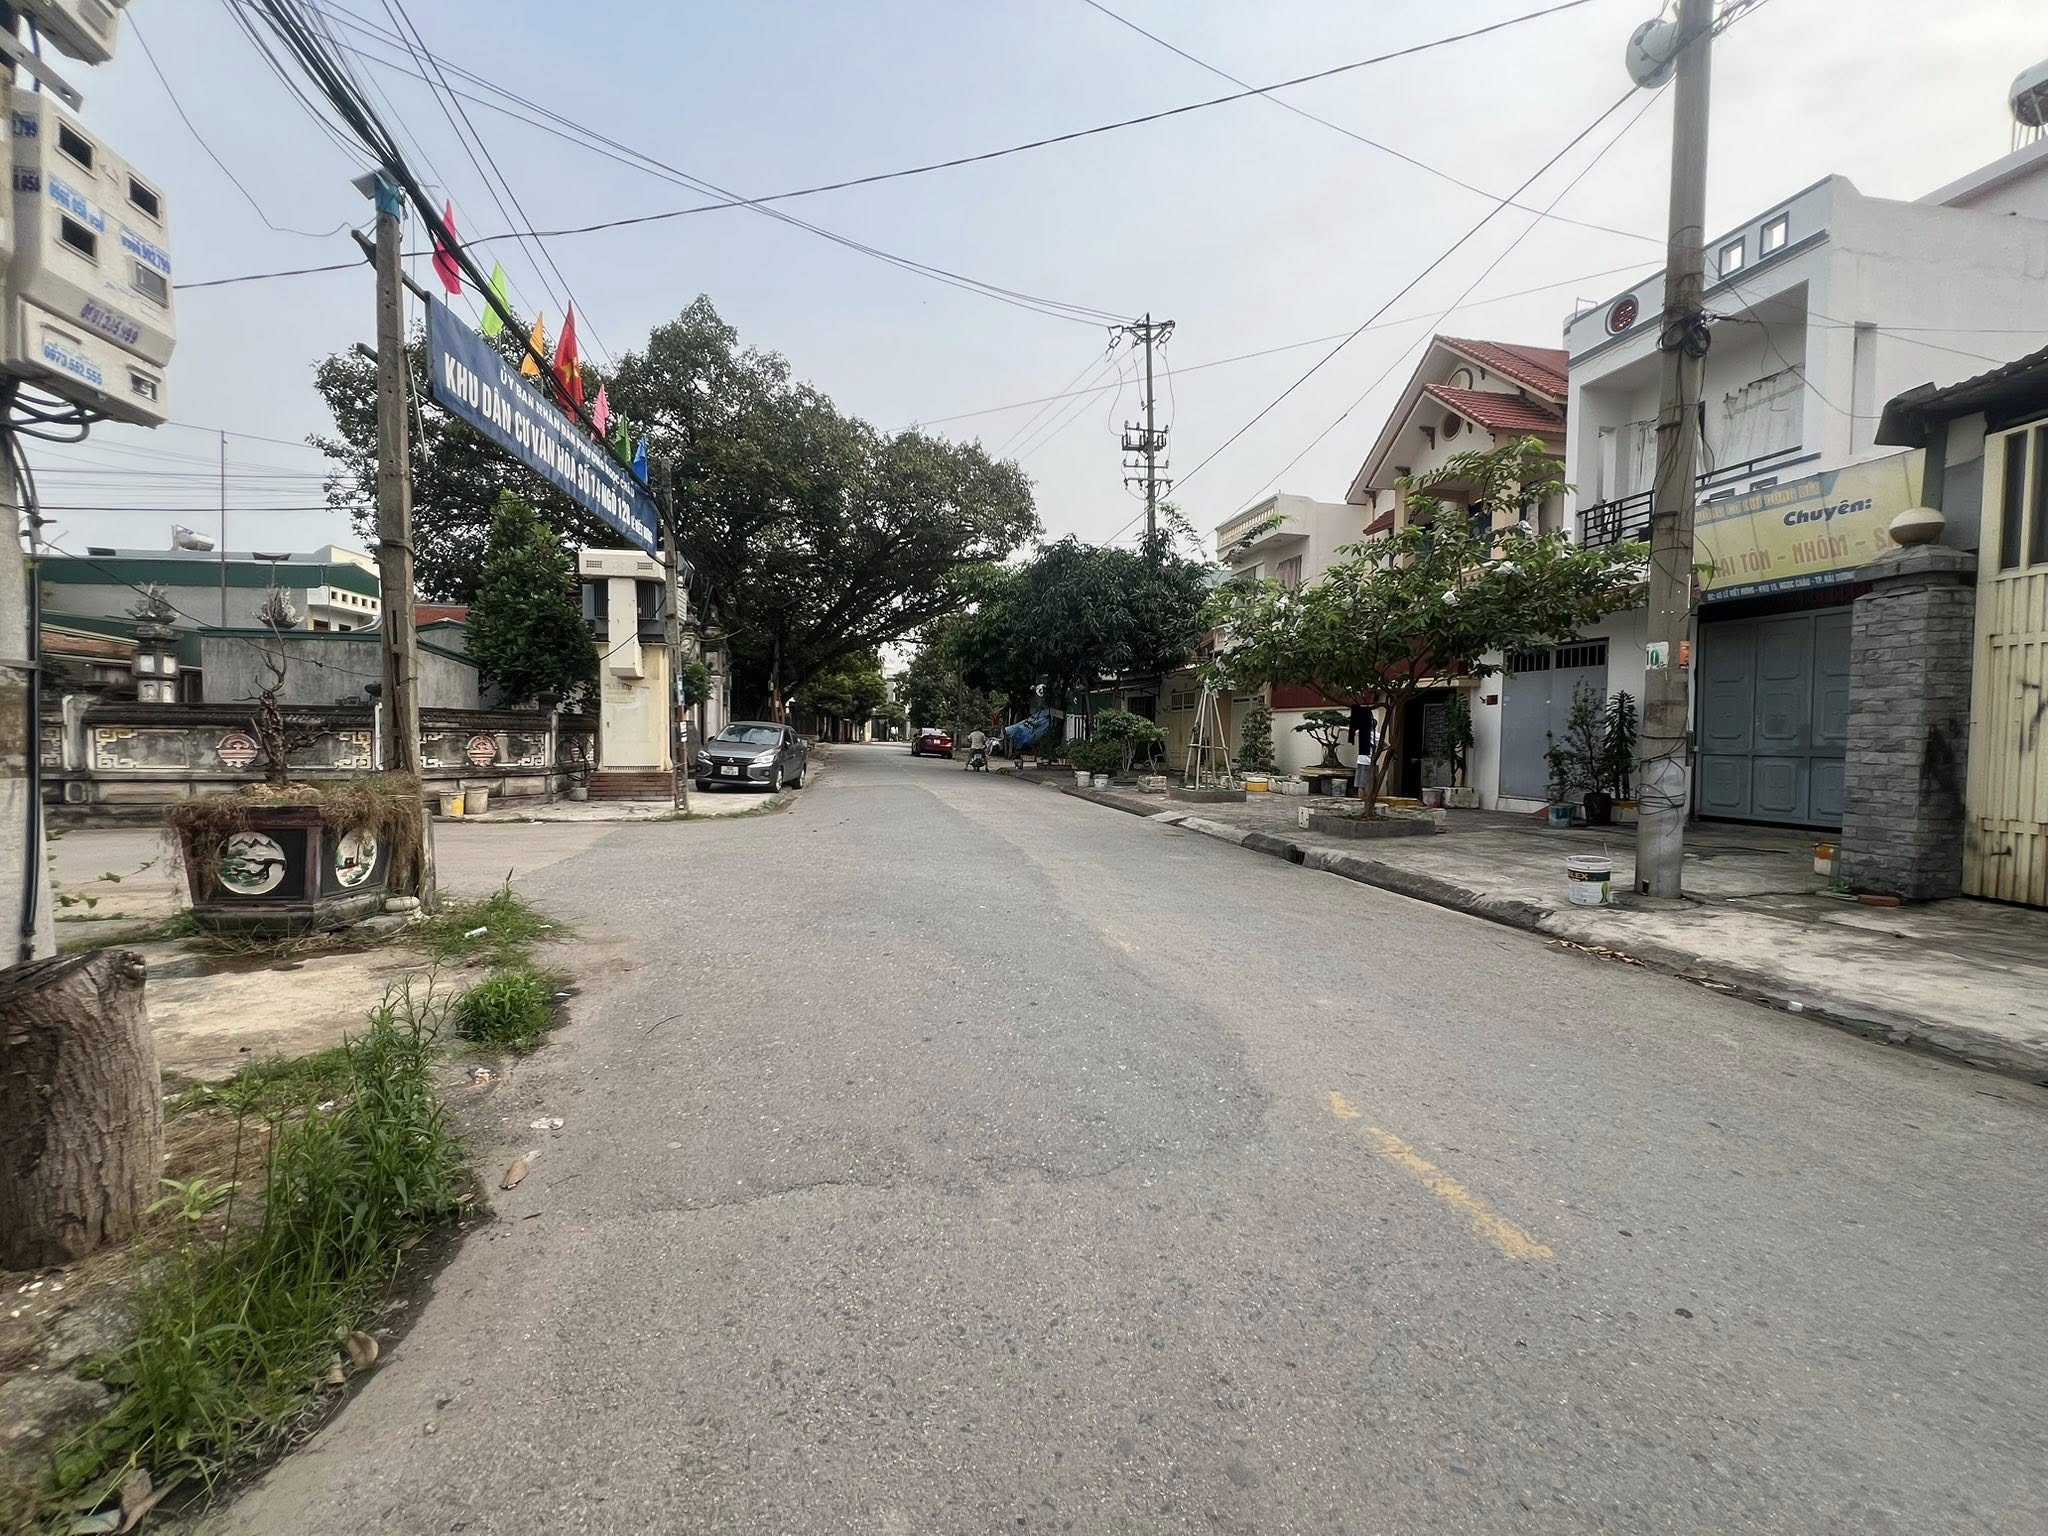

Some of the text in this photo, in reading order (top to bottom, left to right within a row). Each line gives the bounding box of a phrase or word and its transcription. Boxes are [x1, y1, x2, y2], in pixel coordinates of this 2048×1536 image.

[516, 382, 535, 410] BAN
[444, 351, 480, 409] KHU
[482, 382, 512, 435] DÂN
[514, 409, 531, 449] CƯ
[531, 427, 555, 468] VĂN
[557, 446, 577, 485] HÓA
[577, 462, 590, 495] SỐ
[590, 473, 601, 503] 14
[601, 482, 617, 516] NGÕ
[1783, 498, 1873, 527] Chuyên:
[1741, 547, 1771, 573] TÔN
[1791, 533, 1849, 565] NHÔM
